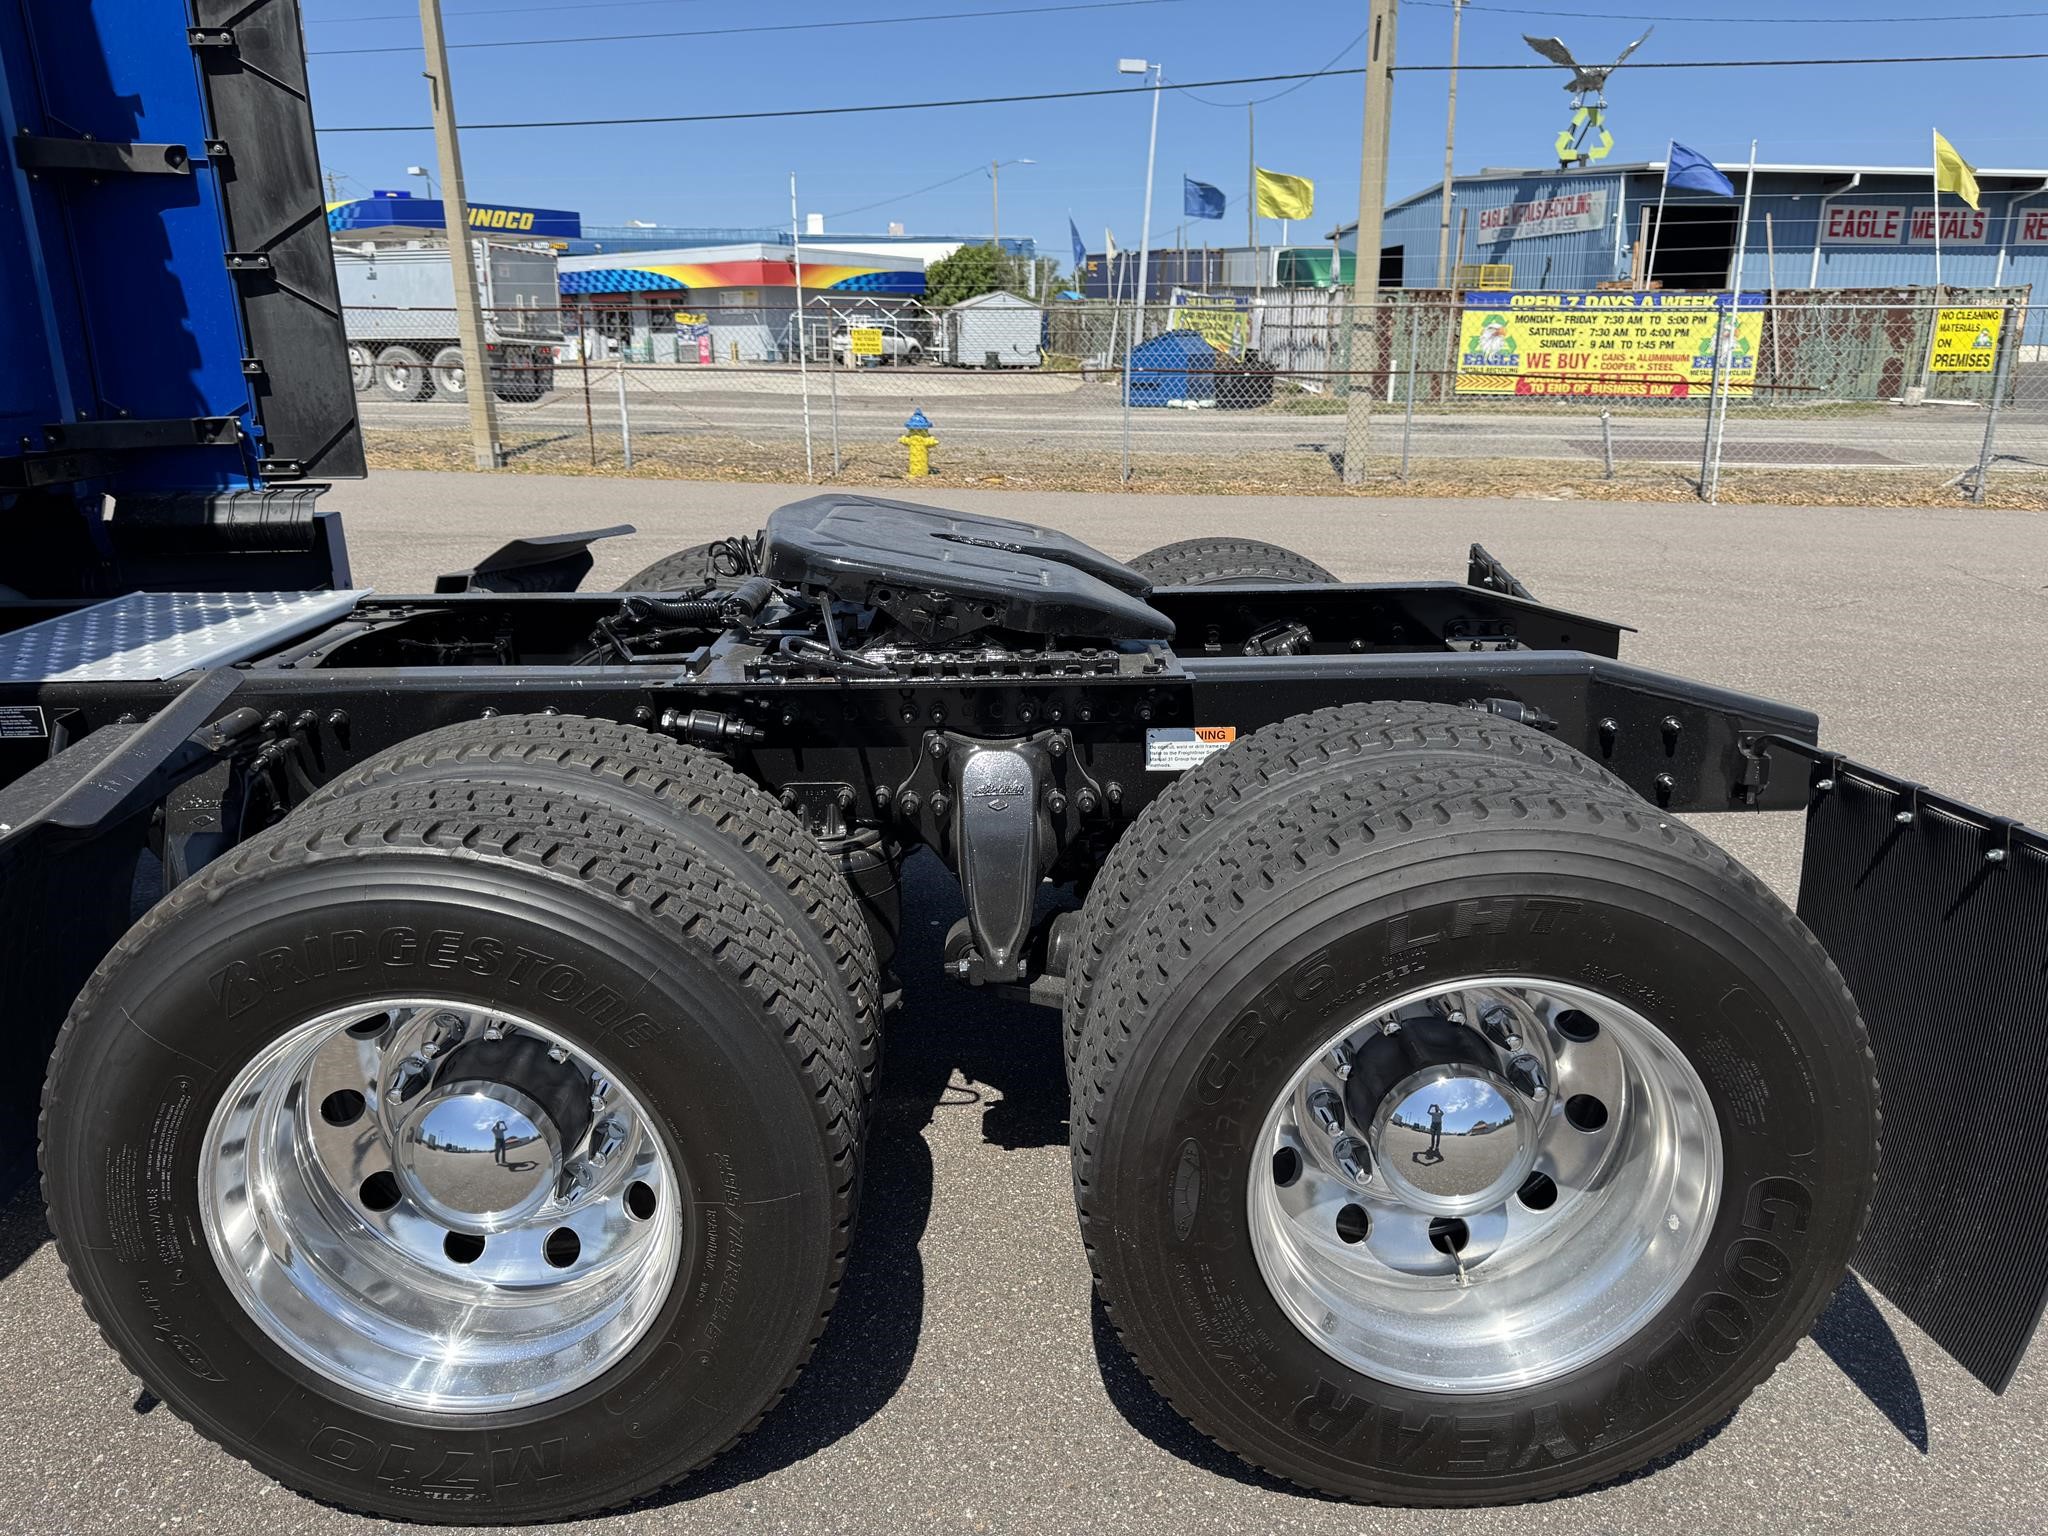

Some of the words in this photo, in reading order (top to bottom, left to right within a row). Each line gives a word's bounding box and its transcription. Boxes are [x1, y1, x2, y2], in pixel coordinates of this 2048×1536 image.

[1480, 208, 1509, 230] EAGLE
[1828, 209, 1900, 238] EAGLE
[1911, 210, 1985, 240] METALS
[1509, 295, 1561, 311] OPEN
[1566, 296, 1580, 311] 7
[1584, 296, 1636, 311] DAYS
[1641, 296, 1655, 311] A
[1660, 296, 1718, 311] WEEK
[1514, 315, 1554, 324] MONDAY
[1564, 315, 1598, 324] FRIDAY
[1604, 316, 1624, 324] 7:30
[1626, 316, 1643, 324] AM
[1650, 316, 1661, 325] TO
[1667, 316, 1689, 325] 5:00
[1691, 316, 1707, 325] PM
[1941, 311, 1954, 320] NO
[1955, 311, 1999, 320] CLEANING
[1528, 327, 1577, 336] SATURDAY
[1590, 328, 1610, 337] 7:30
[1612, 328, 1629, 336] AM
[1635, 328, 1647, 337] TO
[1649, 328, 1672, 337] 4:00
[1674, 328, 1690, 337] PM
[1939, 324, 1981, 332] MATERIALS
[1539, 340, 1577, 349] SUNDAY
[1589, 340, 1596, 349] 9
[1598, 340, 1615, 349] AM
[1620, 341, 1633, 350] TO
[1636, 341, 1656, 349] 1:45
[1659, 341, 1675, 349] PM
[1937, 339, 1952, 348] ON
[1462, 354, 1519, 366] EAGLE
[1526, 353, 1551, 369] WE
[1558, 353, 1592, 369] BUY
[1692, 356, 1754, 369] EALE
[1933, 353, 1991, 368] PREMISES
[1600, 362, 1636, 371] COOPER
[1647, 363, 1673, 371] STEEL
[1530, 384, 1546, 393] TO
[1547, 384, 1571, 393] END
[1573, 384, 1589, 393] OF
[1591, 384, 1648, 394] BUSINESS
[1650, 385, 1674, 395] DAY
[1196, 730, 1226, 740] NING
[207, 925, 666, 1049] BRIDGESTONE
[1195, 947, 1338, 1105] G316
[1385, 898, 1586, 955] LHT
[307, 1425, 568, 1489] M710
